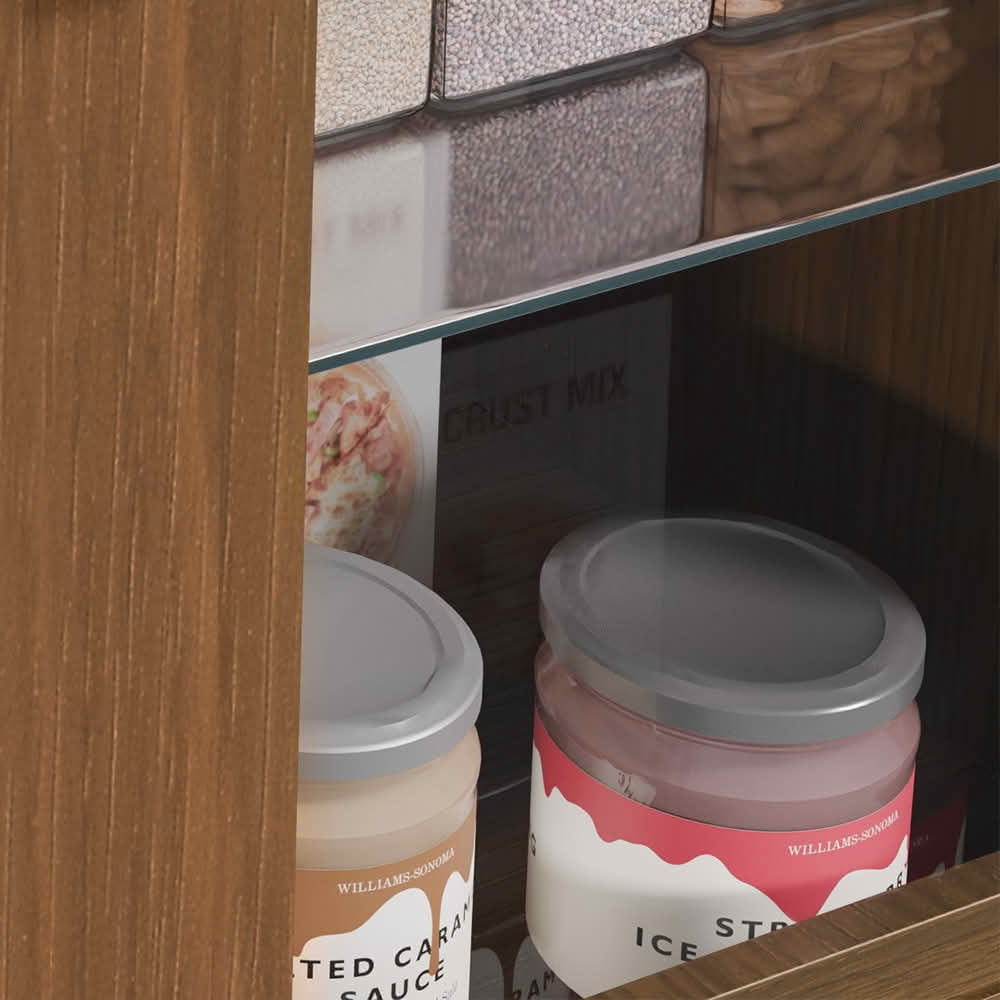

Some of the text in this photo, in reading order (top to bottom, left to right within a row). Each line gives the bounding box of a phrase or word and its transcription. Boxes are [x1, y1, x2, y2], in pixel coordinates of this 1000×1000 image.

[443, 361, 627, 443] CRUST MIX
[788, 809, 900, 857] WILLIAMS-SONOMA
[336, 847, 456, 895] WILLIAMS-SONOMA
[635, 926, 698, 962] ICE
[292, 957, 375, 980] TED
